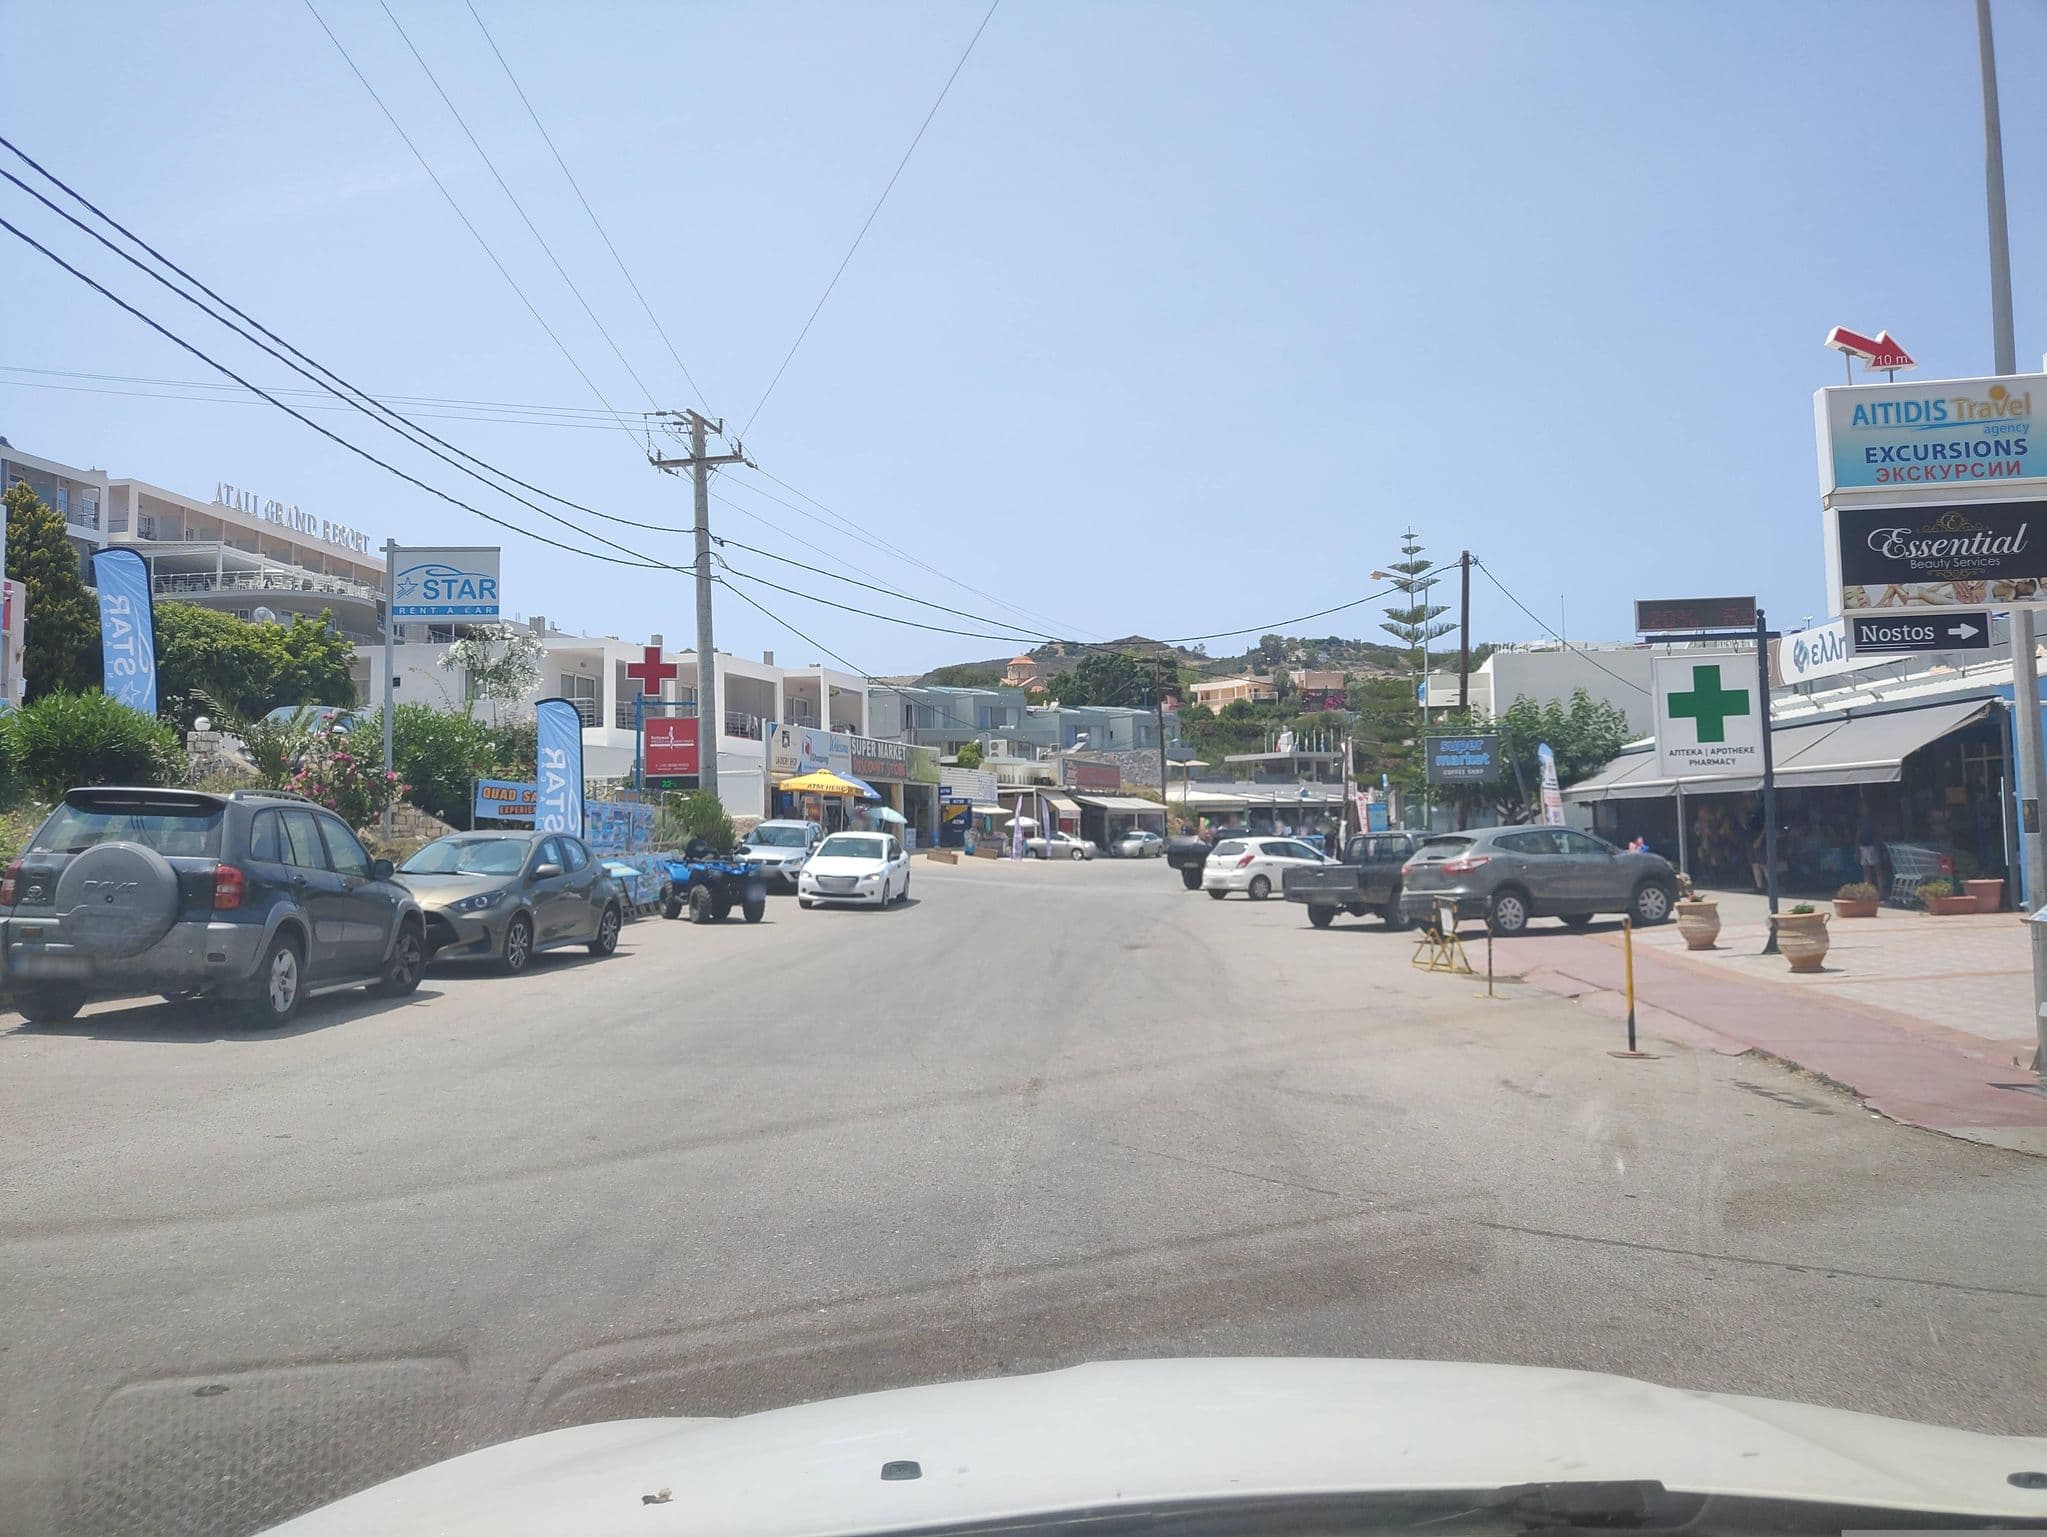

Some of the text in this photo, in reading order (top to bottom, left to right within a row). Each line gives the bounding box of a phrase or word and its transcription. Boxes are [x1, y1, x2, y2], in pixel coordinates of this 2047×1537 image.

[1877, 354, 1908, 365] 10 m
[1852, 391, 2032, 426] AITIDIS Travel
[1983, 422, 2030, 436] agency
[1865, 438, 2029, 464] EXCURSIONS
[1875, 460, 2022, 483] ЭКСКУРСИИ
[264, 499, 317, 536] GRAND
[321, 519, 371, 555] RESORT
[1867, 523, 2028, 559] Essential
[1910, 557, 2001, 569] Beauty Services
[422, 578, 497, 600] STAR
[399, 607, 437, 615] RENT
[1860, 624, 1935, 643] Nostos
[851, 738, 906, 761] SUPER MARKET
[1439, 738, 1485, 753] super
[1710, 747, 1755, 755] APOTHEKE
[1435, 752, 1491, 767] market
[1689, 759, 1736, 767] PHARMACY
[483, 787, 516, 801] QUAD
